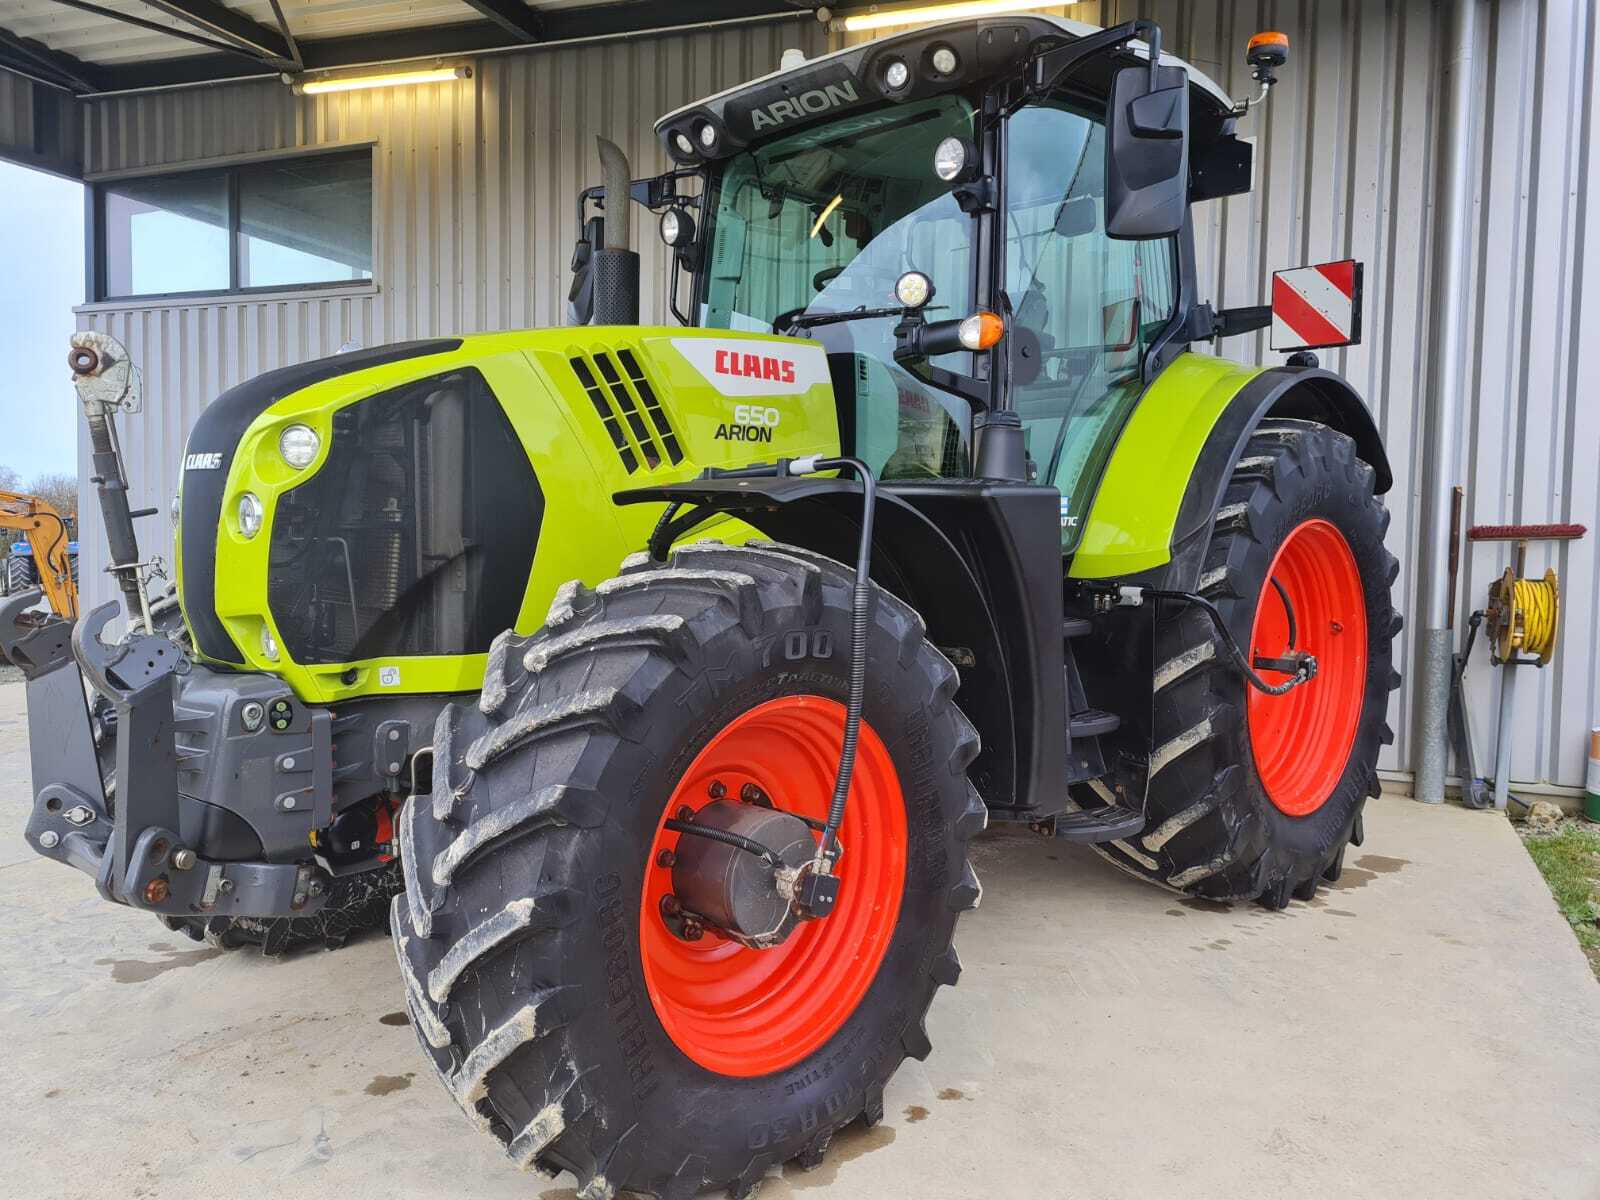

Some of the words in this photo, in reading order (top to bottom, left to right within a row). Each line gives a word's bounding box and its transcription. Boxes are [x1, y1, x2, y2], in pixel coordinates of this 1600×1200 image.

[751, 79, 859, 131] ARION
[714, 350, 796, 383] CLAAS
[734, 404, 780, 427] 650
[714, 423, 772, 443] ARION
[185, 452, 223, 470] CLAAS
